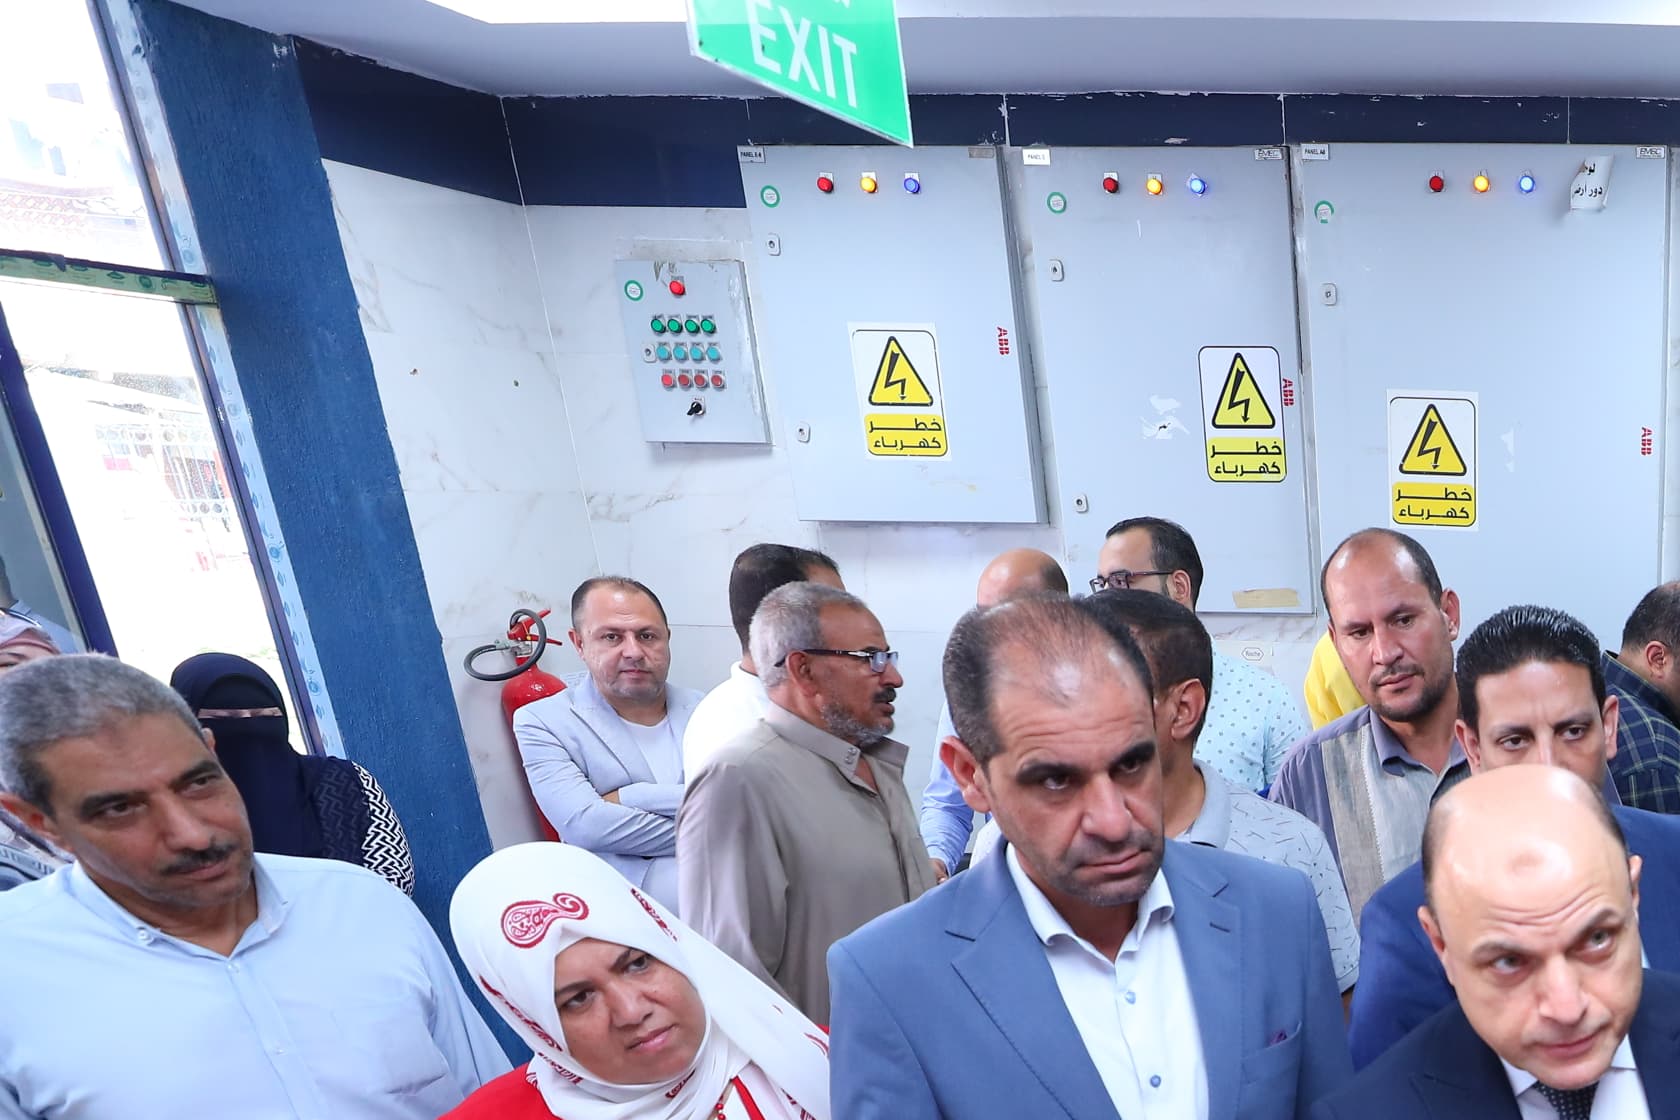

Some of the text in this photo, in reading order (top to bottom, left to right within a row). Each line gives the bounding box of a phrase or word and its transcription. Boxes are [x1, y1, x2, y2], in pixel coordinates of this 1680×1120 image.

[744, 0, 858, 109] EXIT
[997, 326, 1010, 356] ABB
[1282, 377, 1295, 407] ABB
[868, 417, 943, 434] خطر
[873, 435, 942, 451] كهرباء
[1210, 440, 1283, 459] خطر
[1641, 426, 1653, 456] ABB
[1214, 460, 1281, 477] كهرباء
[1395, 487, 1473, 502] خطر
[1398, 504, 1470, 521] كهرباء
